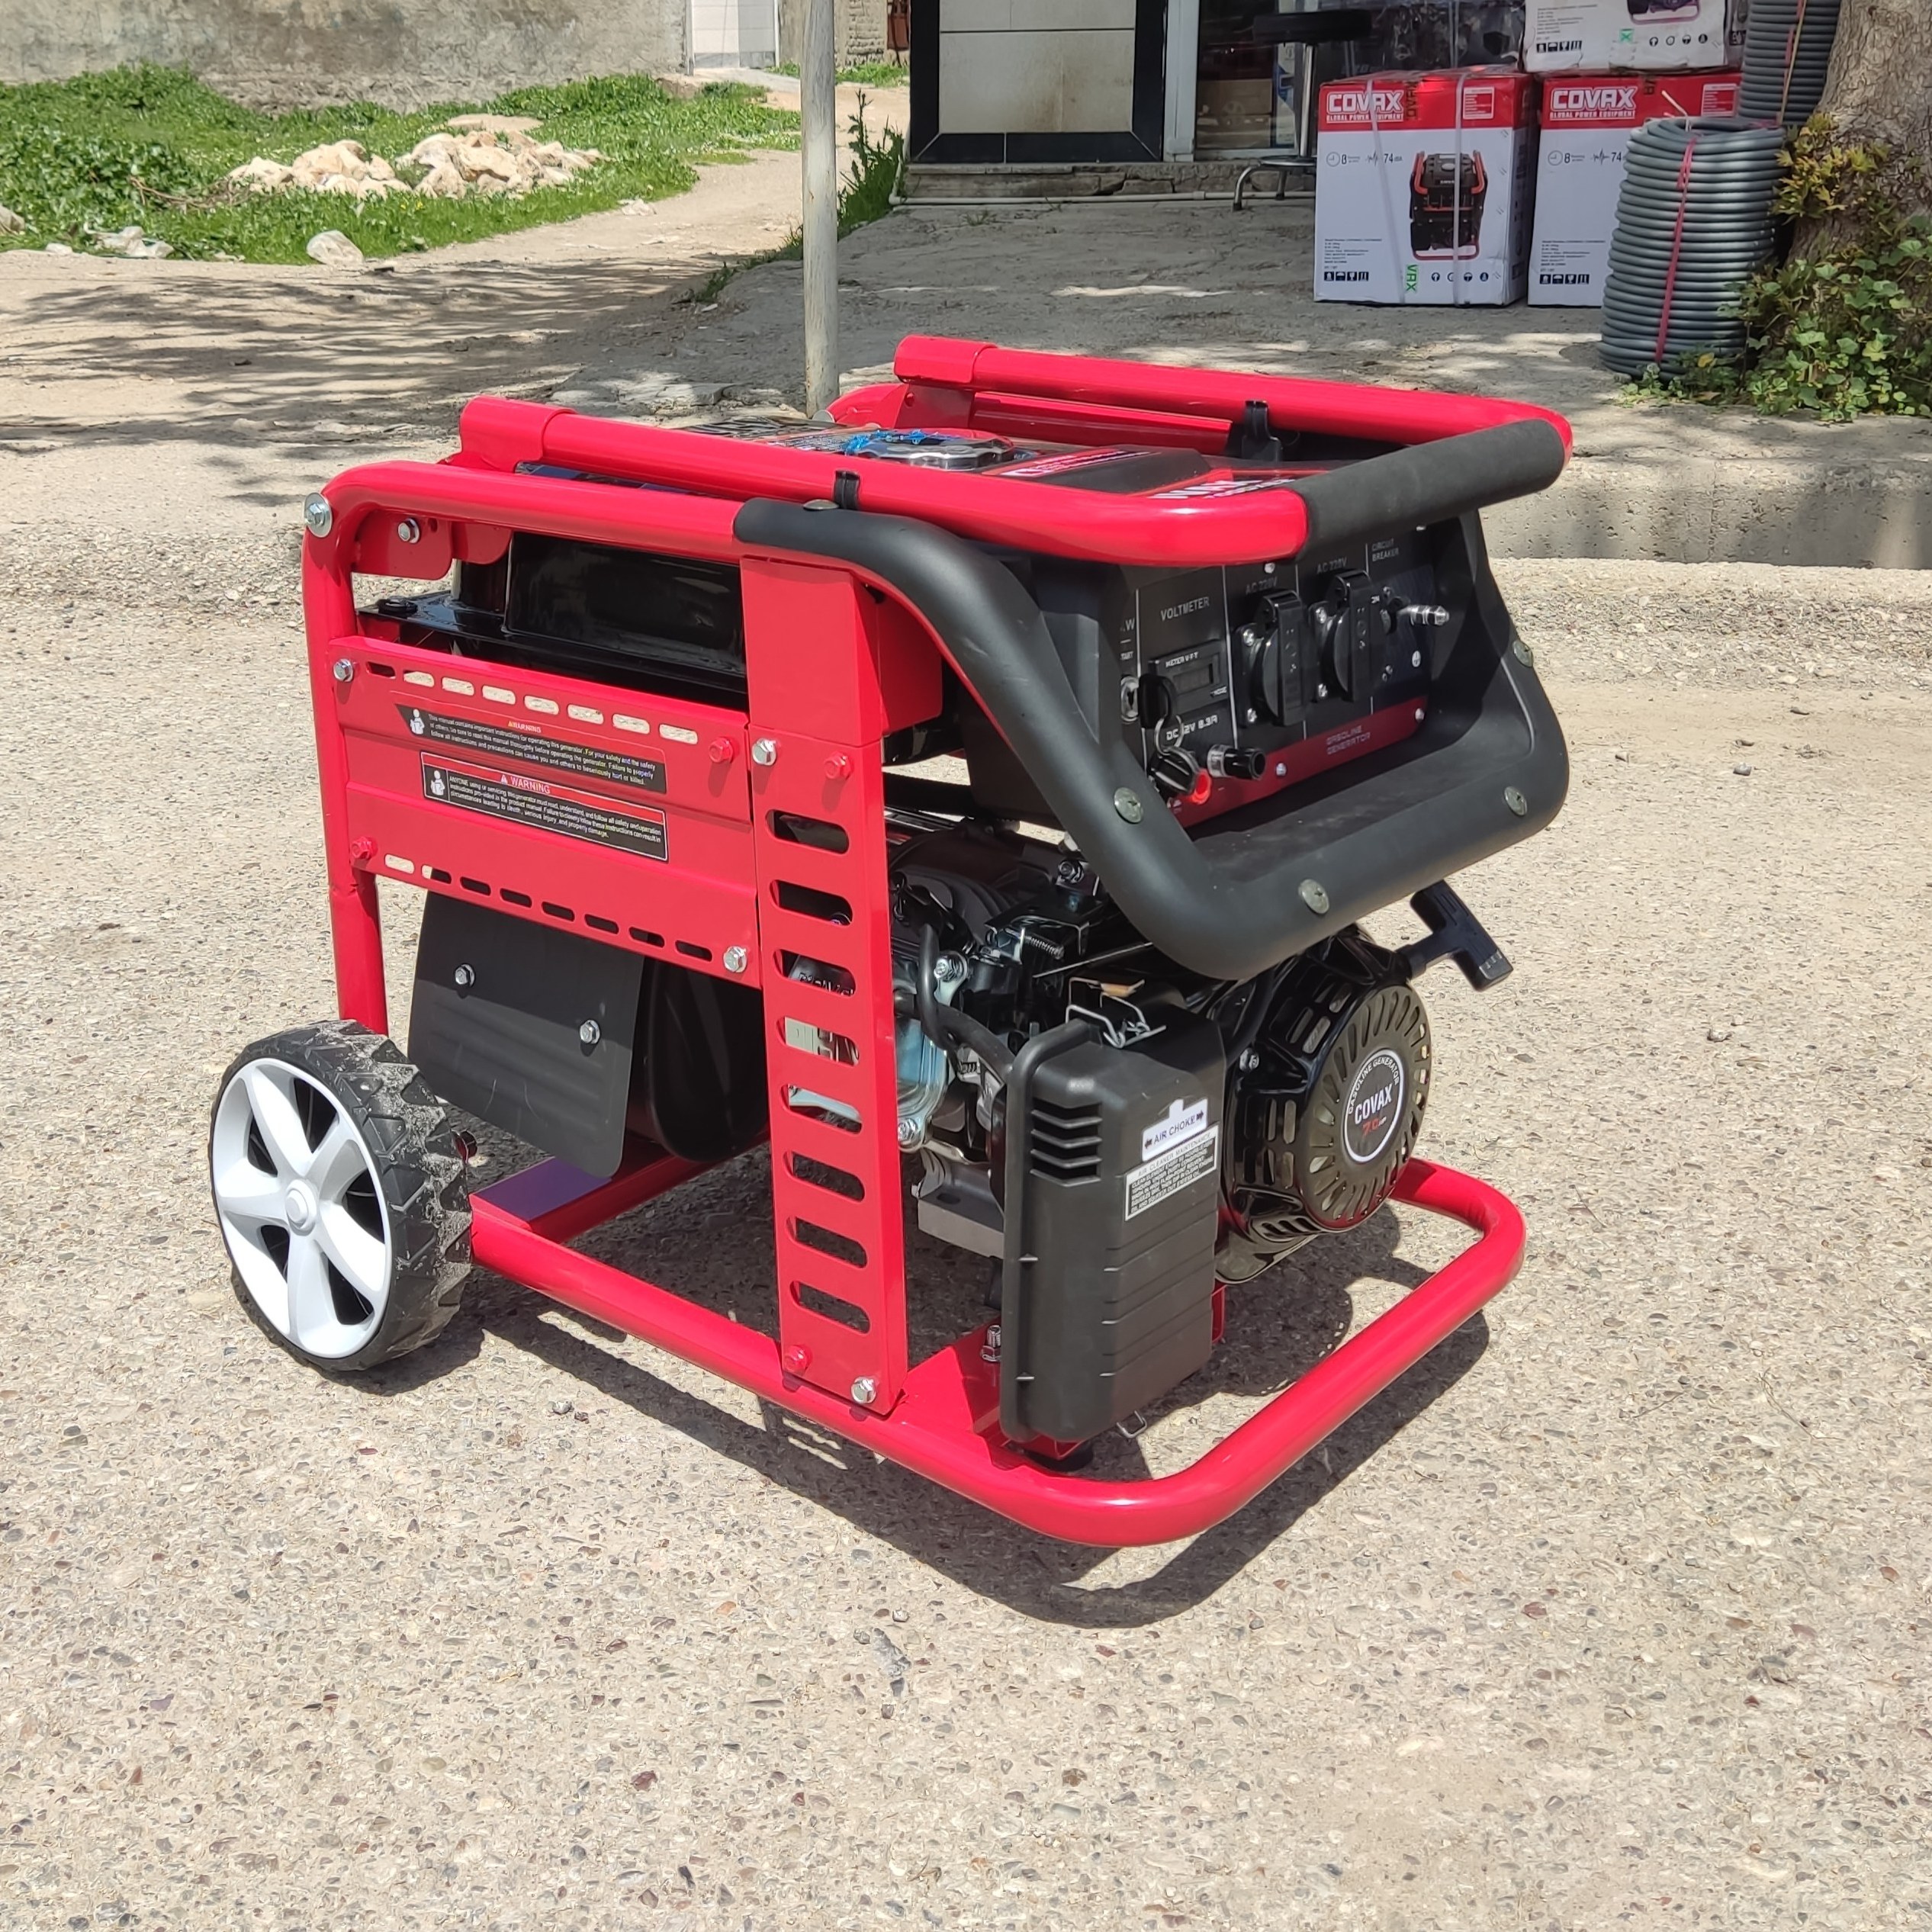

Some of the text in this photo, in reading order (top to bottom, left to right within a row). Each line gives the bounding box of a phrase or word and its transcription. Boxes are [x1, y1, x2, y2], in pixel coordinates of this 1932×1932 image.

[1327, 91, 1404, 114] COVAX
[1551, 86, 1638, 111] COVAX
[1384, 153, 1394, 164] 74
[1564, 153, 1570, 164] 8
[1611, 152, 1622, 163] 74
[1372, 548, 1400, 562] BREAKER
[1317, 563, 1328, 574] AC
[1246, 583, 1259, 595] AC
[1161, 596, 1210, 622] VOLTMETER
[1120, 651, 1134, 661] TART
[1165, 655, 1185, 668] METER
[513, 721, 542, 733] WARNING
[1166, 728, 1180, 741] DC
[1181, 722, 1196, 735] 2V
[1326, 725, 1362, 746] GASOLINE
[429, 713, 438, 722] This
[439, 717, 455, 726] manual
[455, 721, 473, 730] contains
[474, 724, 494, 734] important
[495, 728, 519, 740] instructions
[528, 736, 550, 747] operating
[606, 754, 622, 763] safety
[622, 757, 632, 765] and
[640, 762, 656, 772] safety
[1327, 732, 1371, 755] GENERATOR
[430, 729, 444, 739] follow
[451, 735, 477, 747] instructions
[487, 744, 515, 756] precautions
[524, 751, 539, 761] cause
[540, 755, 548, 763] you
[560, 760, 576, 770] others
[612, 771, 622, 780] hurt
[493, 737, 510, 746] manual
[510, 740, 534, 752] thoroughly
[535, 746, 550, 755] before
[551, 751, 573, 761] operating
[608, 762, 625, 772] Failure
[632, 768, 654, 780] properly
[510, 776, 551, 794] WARNING
[449, 776, 469, 787] ANYONE
[469, 782, 481, 791] using
[487, 786, 507, 797] servicing
[536, 799, 548, 807] must
[585, 812, 594, 820] and
[593, 813, 608, 822] follow
[615, 818, 629, 828] safety
[449, 783, 474, 795] instructions
[474, 790, 495, 800] provided
[508, 799, 526, 808] product
[526, 803, 542, 812] manual
[592, 820, 606, 829] these
[605, 824, 633, 837] instructions
[450, 791, 482, 804] circumstances
[483, 798, 500, 809] leading
[524, 809, 542, 820] serious
[542, 814, 558, 825] injury
[568, 821, 589, 834] property
[1348, 1056, 1400, 1114] GASOLINE GENERATOR
[1355, 1083, 1394, 1125] COVAX
[1153, 1114, 1195, 1145] AIR CHOKE
[1138, 1168, 1148, 1177] AIR
[1149, 1153, 1175, 1171] CLEANER
[1175, 1132, 1210, 1155] MAINTENANCE
